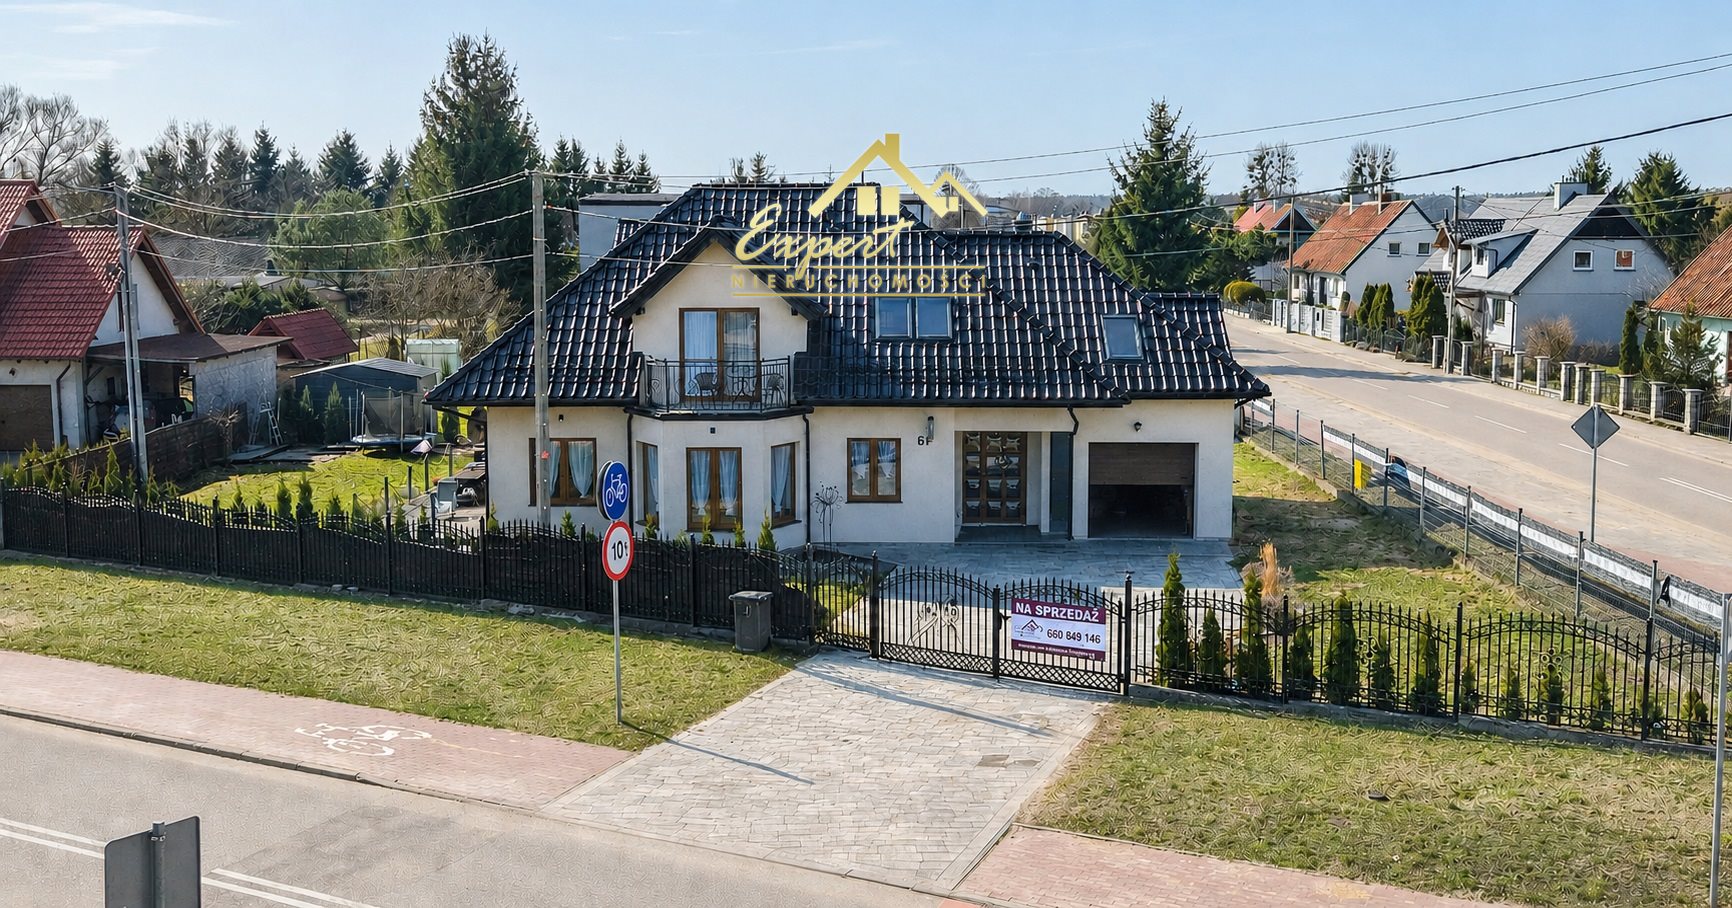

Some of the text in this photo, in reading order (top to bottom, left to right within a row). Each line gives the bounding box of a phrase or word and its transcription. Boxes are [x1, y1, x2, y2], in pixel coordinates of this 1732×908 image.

[1016, 602, 1099, 622] NA SPRZEDAŻ
[1047, 628, 1063, 640] 660
[1066, 630, 1082, 642] 849
[1085, 633, 1101, 644] 146
